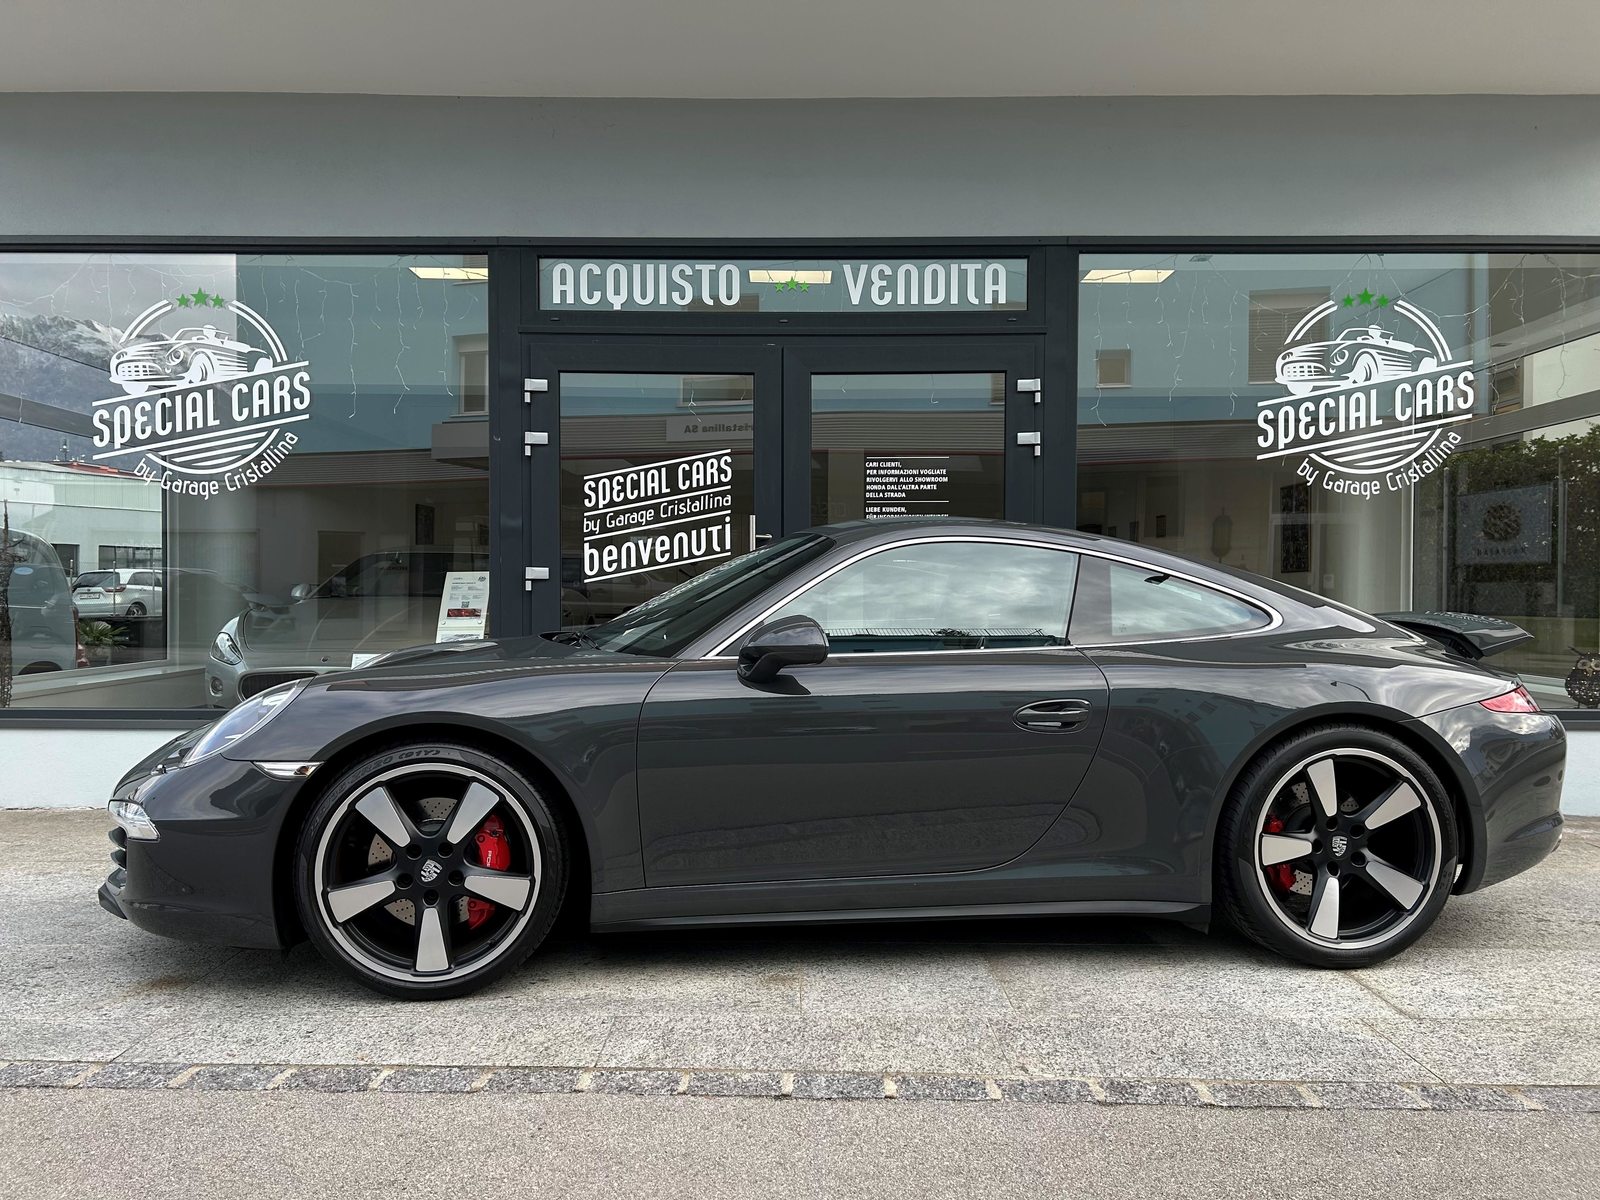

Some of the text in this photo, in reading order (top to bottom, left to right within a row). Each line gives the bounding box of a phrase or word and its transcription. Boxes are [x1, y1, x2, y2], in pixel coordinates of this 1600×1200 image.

[552, 262, 1007, 311] ACQUISTO VENDITA
[92, 371, 311, 450] SPECIAL CARS
[1257, 371, 1475, 450] SPECIAL CARS
[133, 431, 299, 500] by Garage Cristallina
[583, 455, 732, 508] SPECIAL CARS
[1296, 431, 1462, 500] by Garage Cristallina
[583, 493, 732, 535] by Garage Cristallina
[583, 515, 731, 576] benvenuti
